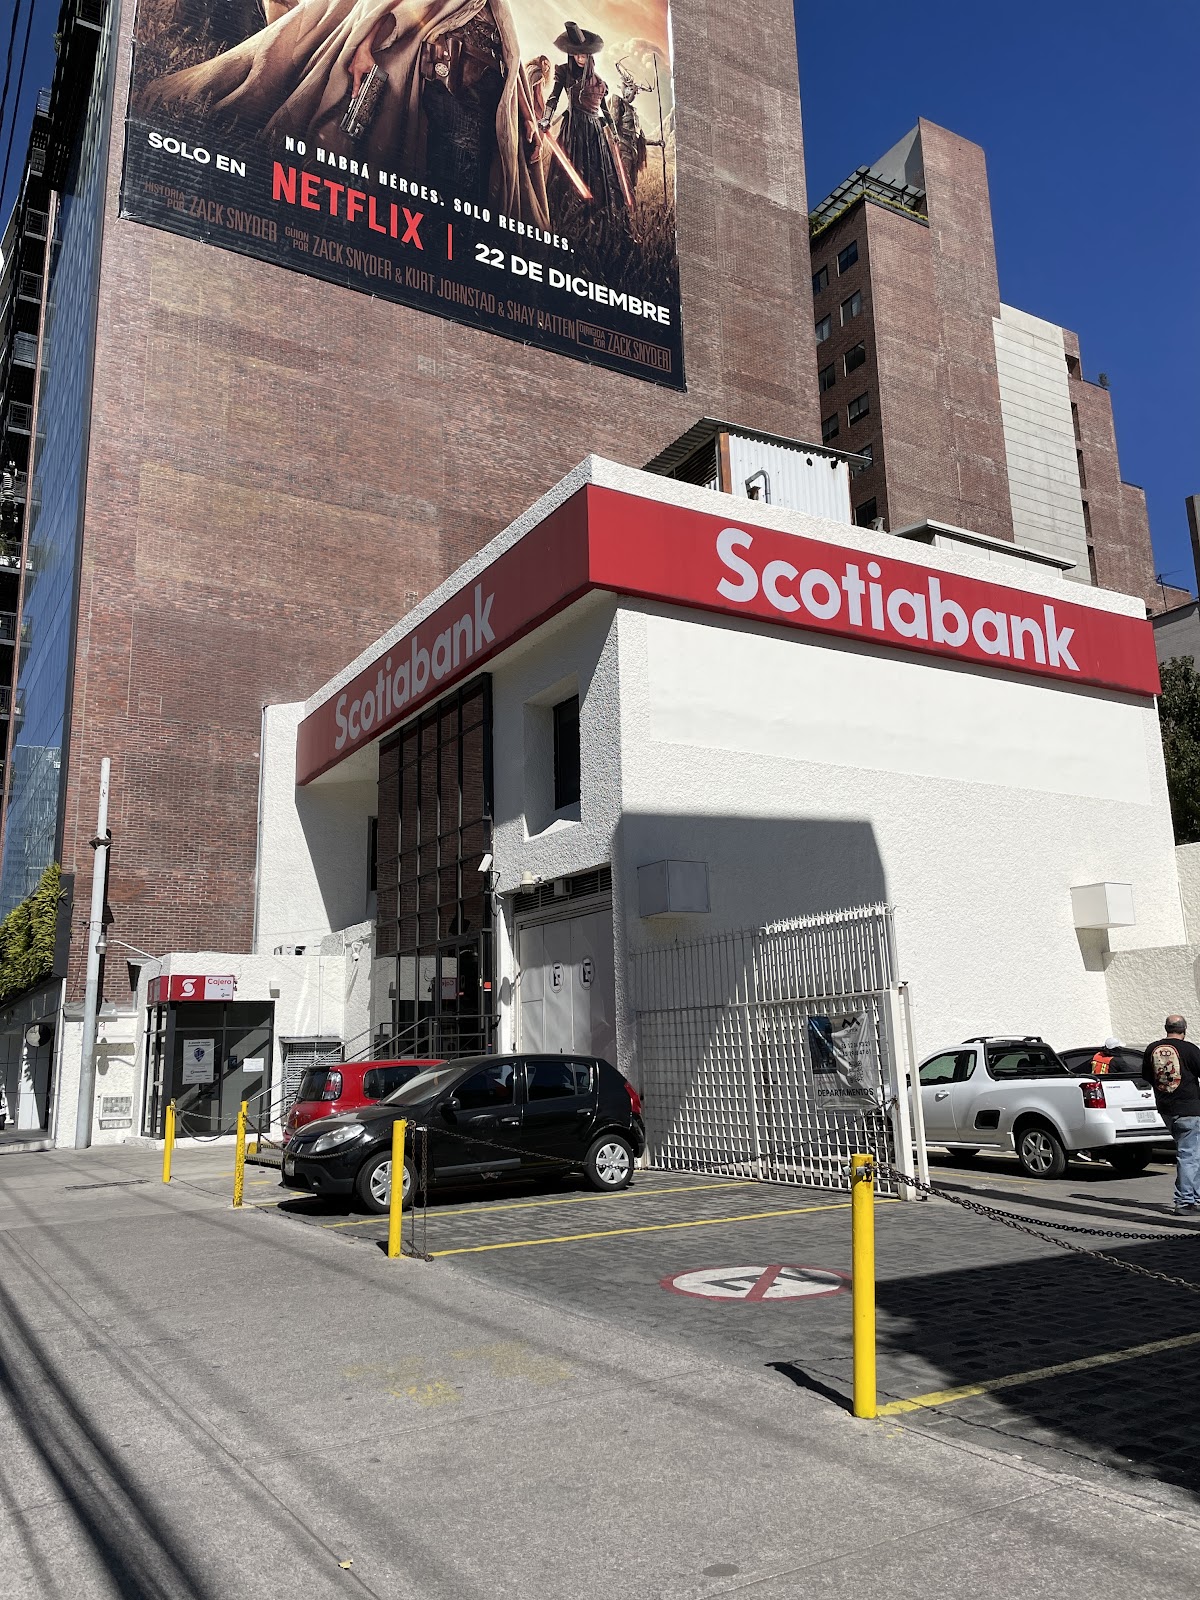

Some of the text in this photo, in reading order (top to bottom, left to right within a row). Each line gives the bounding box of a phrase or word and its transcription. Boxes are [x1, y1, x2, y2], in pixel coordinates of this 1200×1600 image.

[148, 132, 246, 177] SOLO EN
[145, 181, 185, 200] HISTORIA
[167, 198, 185, 211] POR
[272, 161, 424, 250] NETFLIX
[285, 134, 575, 253] NO HABRÁ HÉROES. SOLO REBELDES.
[189, 195, 278, 242] ZACK SNYDER
[293, 239, 309, 252] POR
[312, 235, 575, 340] ZACK SNYDER & KURT JOHNSTAD & SHAY HATTEN
[475, 243, 671, 326] 22 DE DICIEMBRE
[593, 338, 606, 349] POR
[607, 333, 669, 370] ZACK SNYDER
[716, 527, 1080, 672] Scotiabank
[335, 583, 496, 750] Scotiabank
[208, 978, 231, 986] Cajero
[818, 1087, 874, 1097] DEPARTAMENTOS
